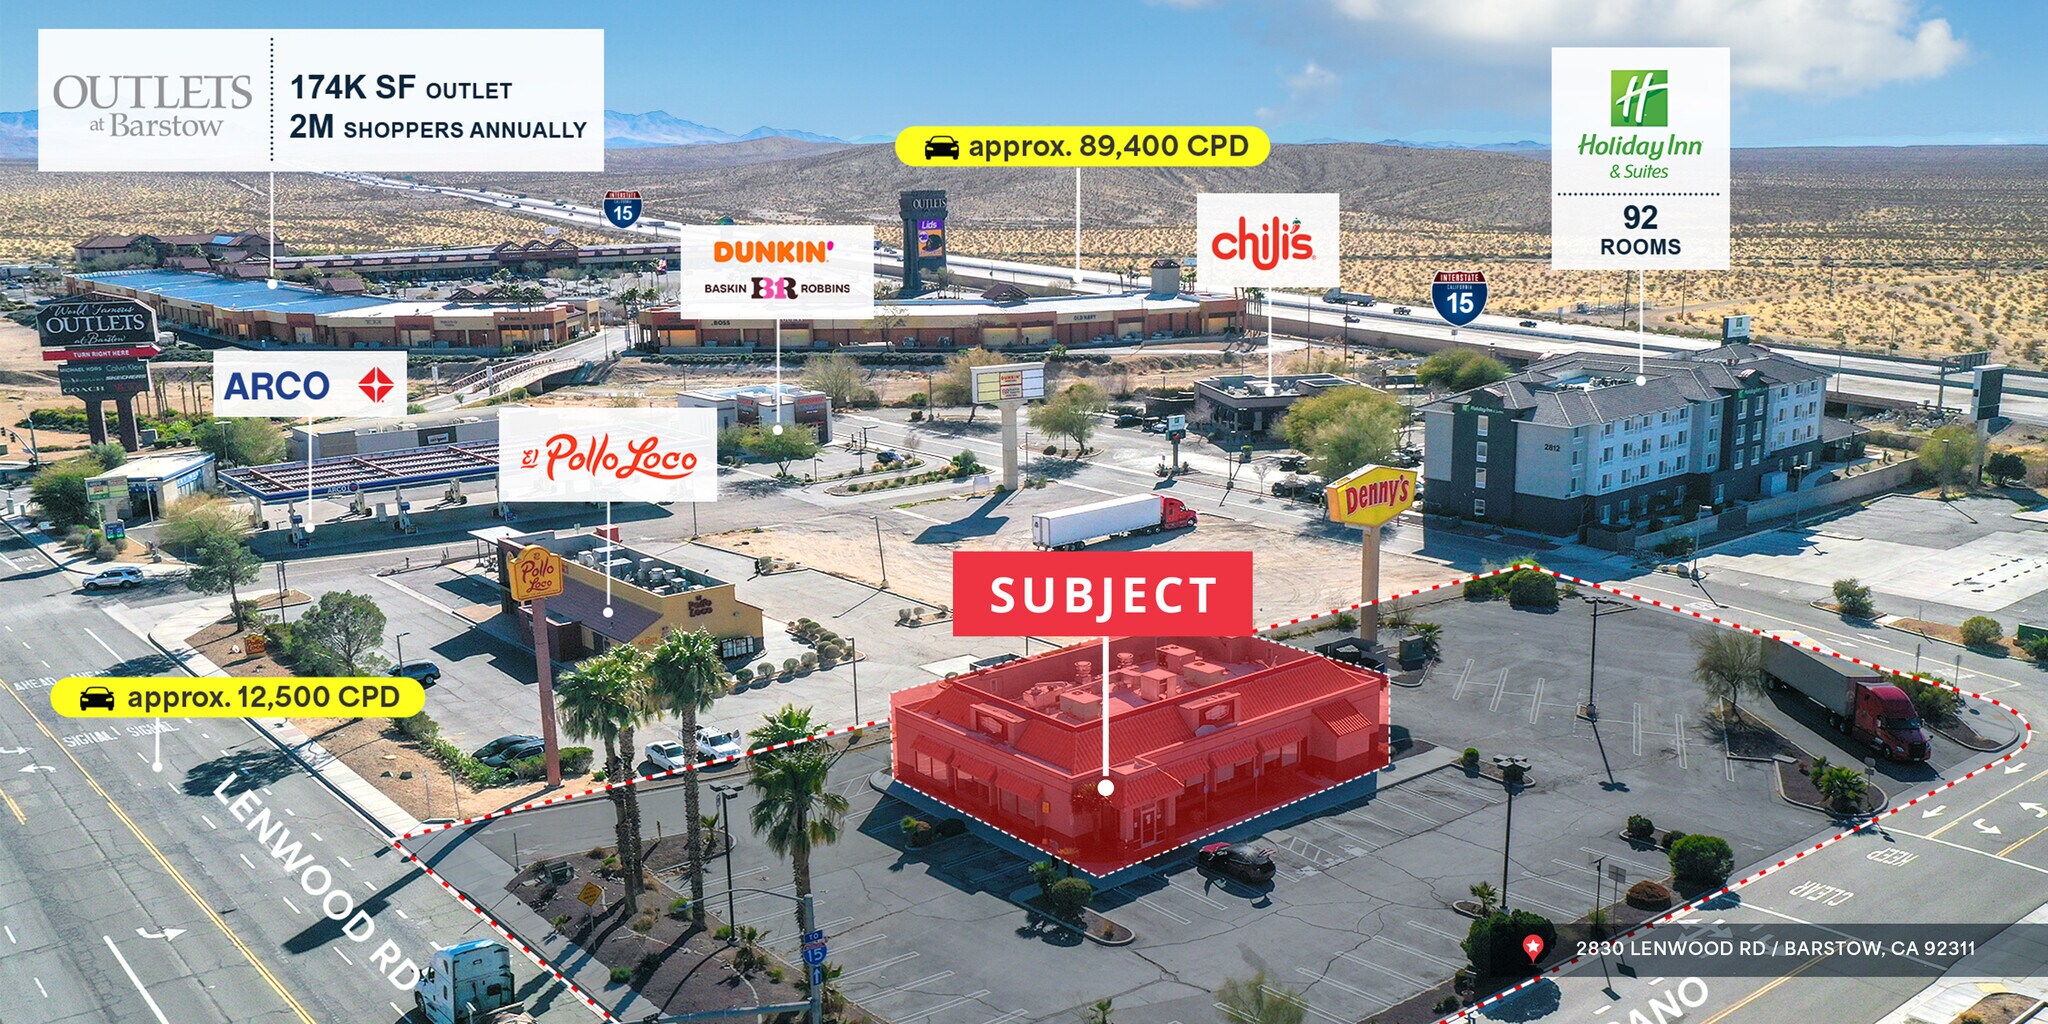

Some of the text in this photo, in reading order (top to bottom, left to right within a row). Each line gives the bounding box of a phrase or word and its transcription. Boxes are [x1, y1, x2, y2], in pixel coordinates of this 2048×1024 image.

[921, 221, 938, 229] Lids
[46, 313, 145, 334] OUTLETS
[1544, 443, 1561, 452] 2812
[1345, 474, 1410, 516] Denny's
[521, 557, 554, 583] Pollo
[526, 577, 552, 593] Loco
[1866, 846, 1920, 867] KEEP
[1789, 880, 1854, 907] CLEAR
[809, 932, 819, 940] TO
[807, 947, 823, 962] 15
